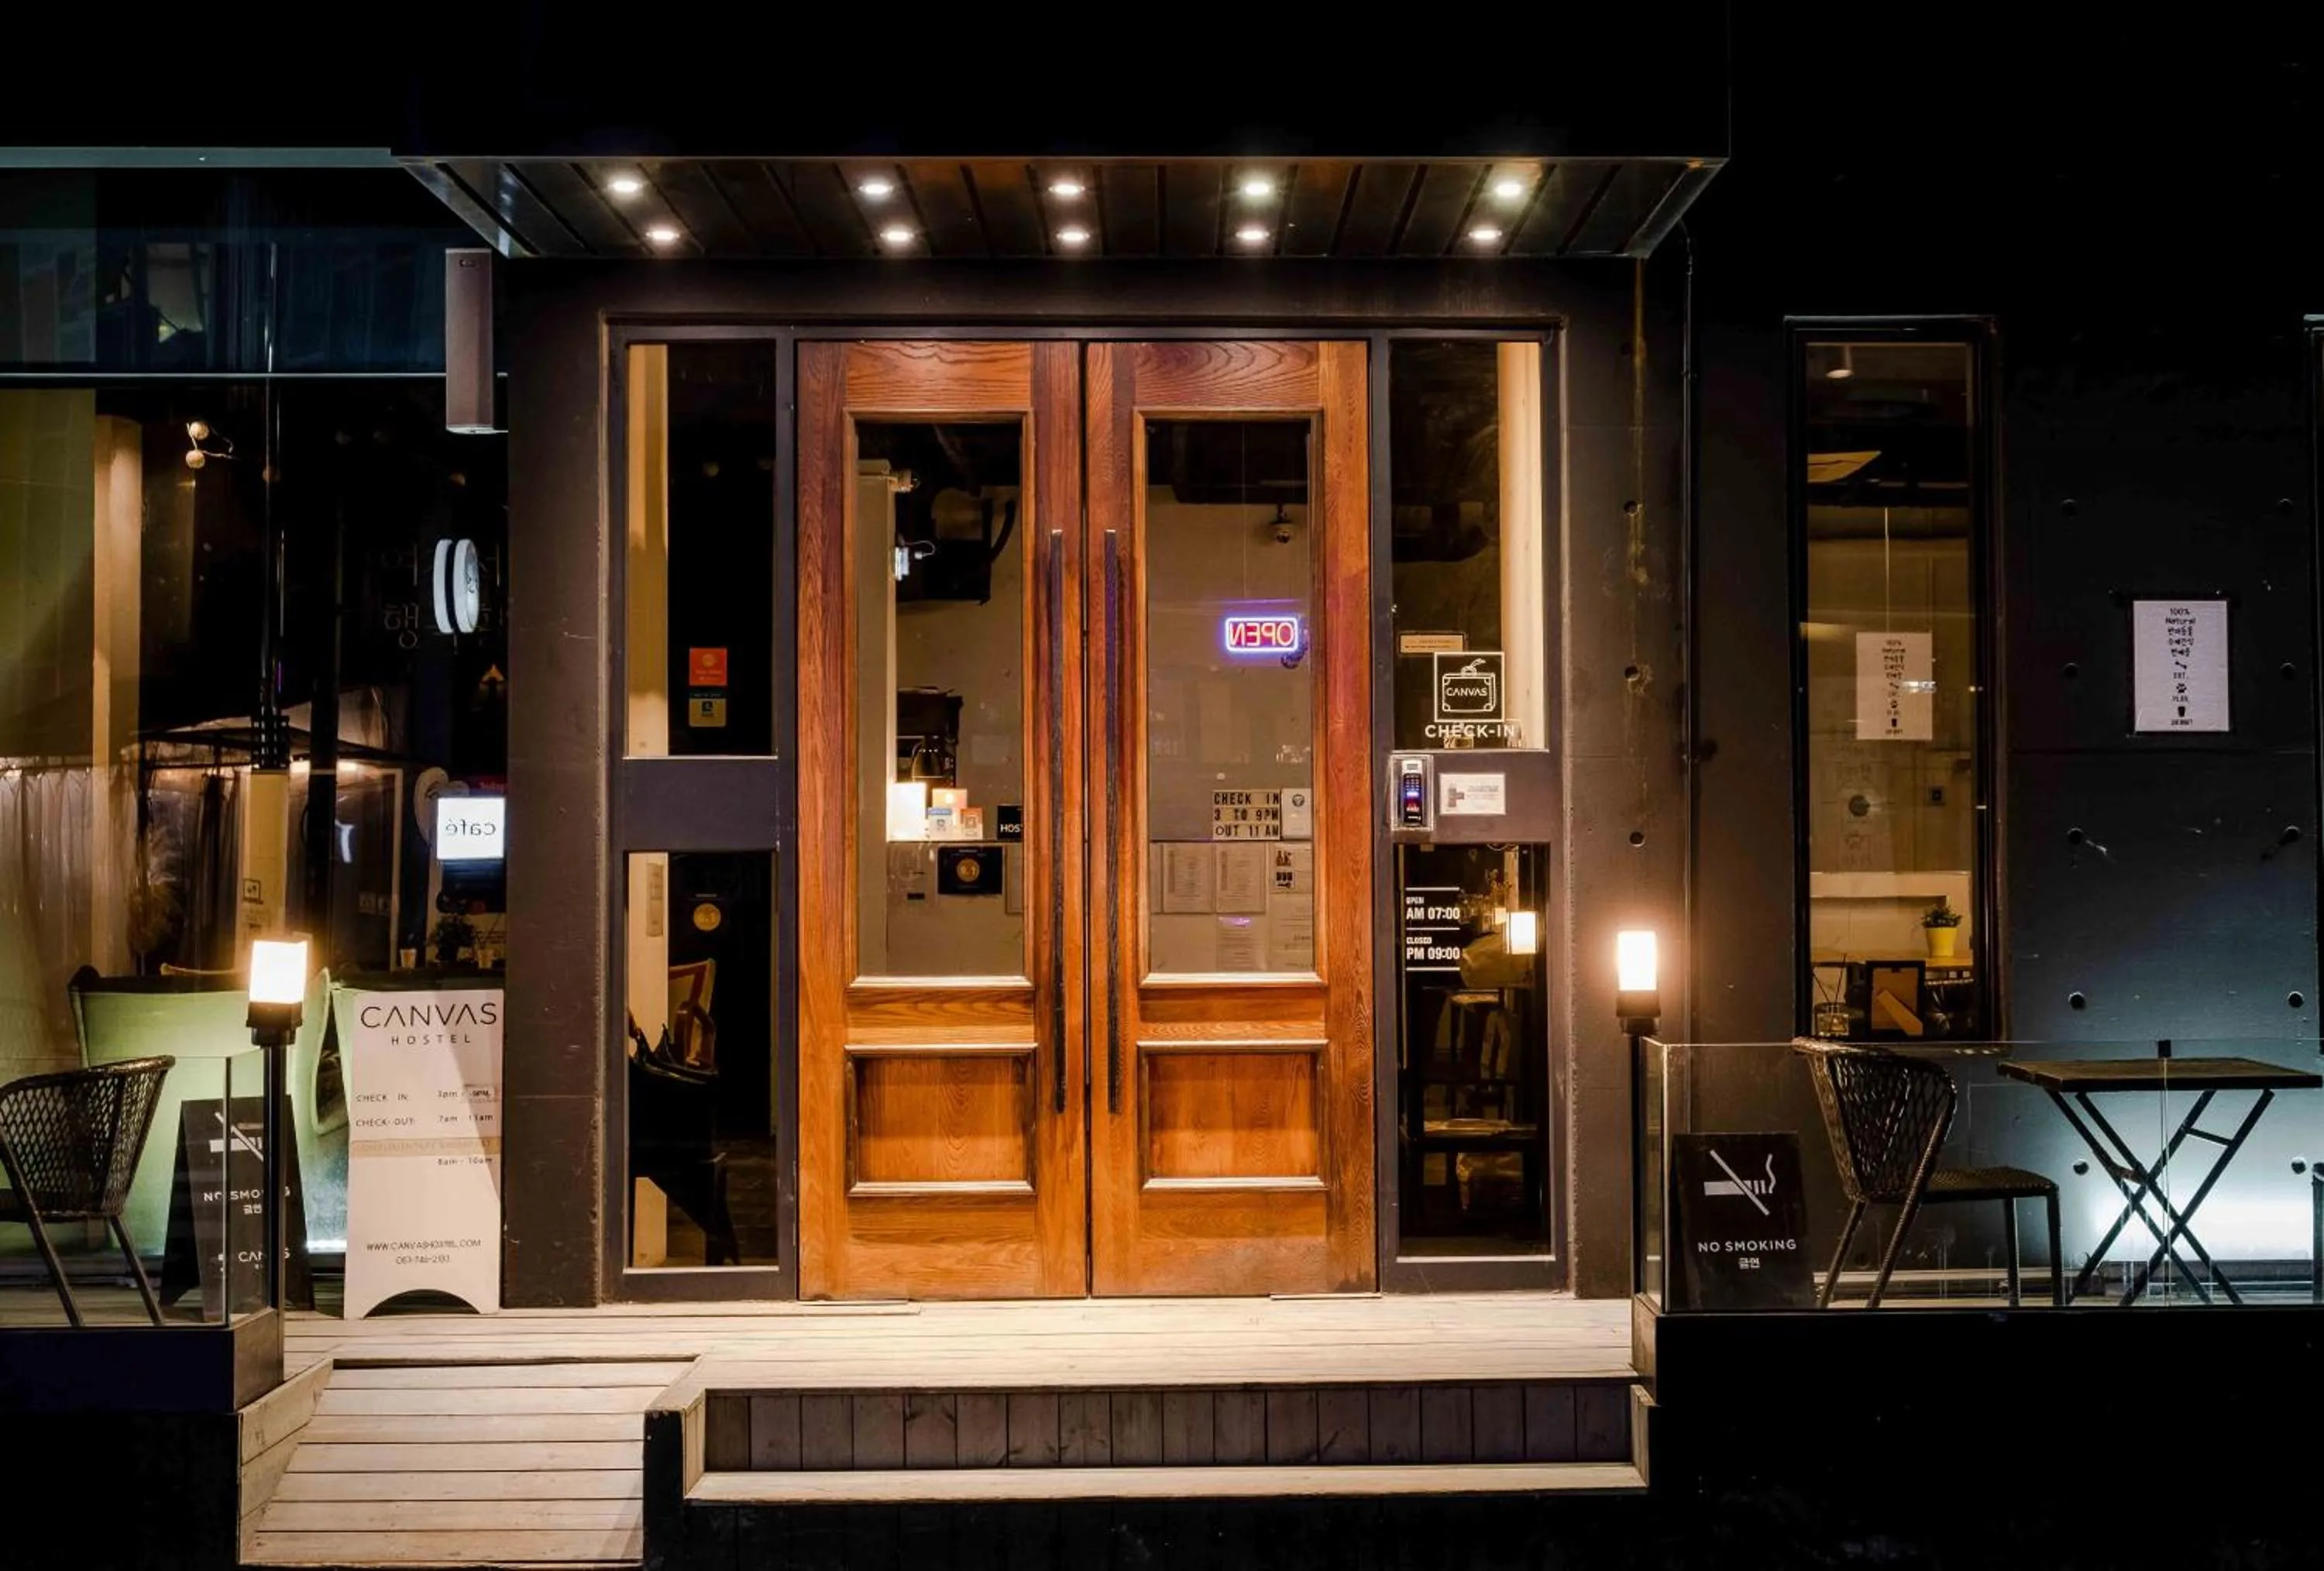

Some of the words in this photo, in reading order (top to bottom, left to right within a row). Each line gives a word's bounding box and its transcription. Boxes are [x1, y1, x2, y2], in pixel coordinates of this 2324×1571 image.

[1446, 687, 1487, 696] CANVAS
[1425, 724, 1516, 738] CHECK-IN
[1214, 792, 1251, 805] CHECK
[1266, 792, 1280, 805] IN
[1214, 810, 1221, 821] 3
[1234, 809, 1248, 821] TO
[1256, 809, 1279, 821] 9PM
[1215, 824, 1239, 837] OUT
[1249, 825, 1260, 837] 11
[1264, 824, 1279, 837] AM
[1406, 896, 1425, 905] OPEN
[1406, 907, 1425, 920] AM
[1428, 907, 1460, 920] 07:00
[1406, 947, 1425, 960] PM
[1428, 947, 1460, 960] 09:00
[360, 1002, 497, 1029] CANVAS
[391, 1035, 471, 1046] HOSTEL
[356, 1093, 387, 1103] CHECK
[1698, 1242, 1720, 1253] NO
[1725, 1239, 1797, 1252] SMOKING
